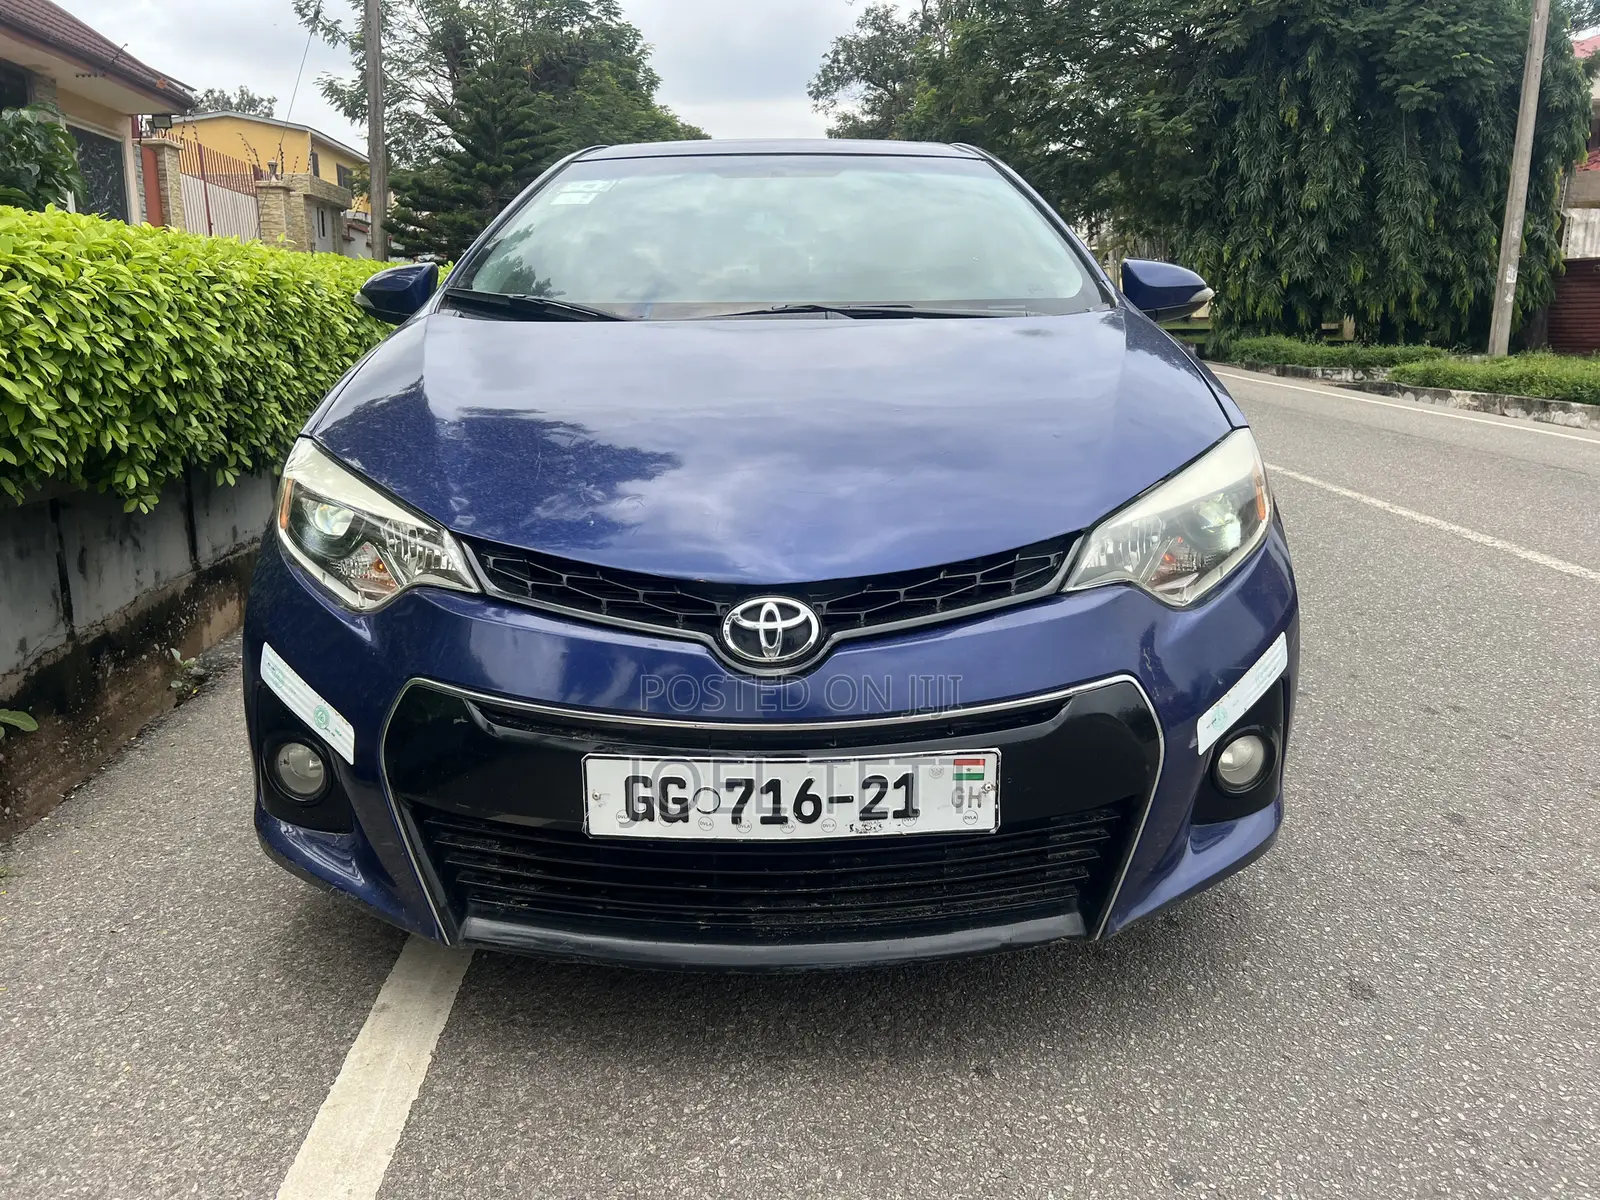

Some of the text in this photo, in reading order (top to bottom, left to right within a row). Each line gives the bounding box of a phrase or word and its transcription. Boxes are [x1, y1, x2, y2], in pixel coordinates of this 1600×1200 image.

[624, 771, 921, 825] GG 716-21
[951, 786, 982, 809] GH
